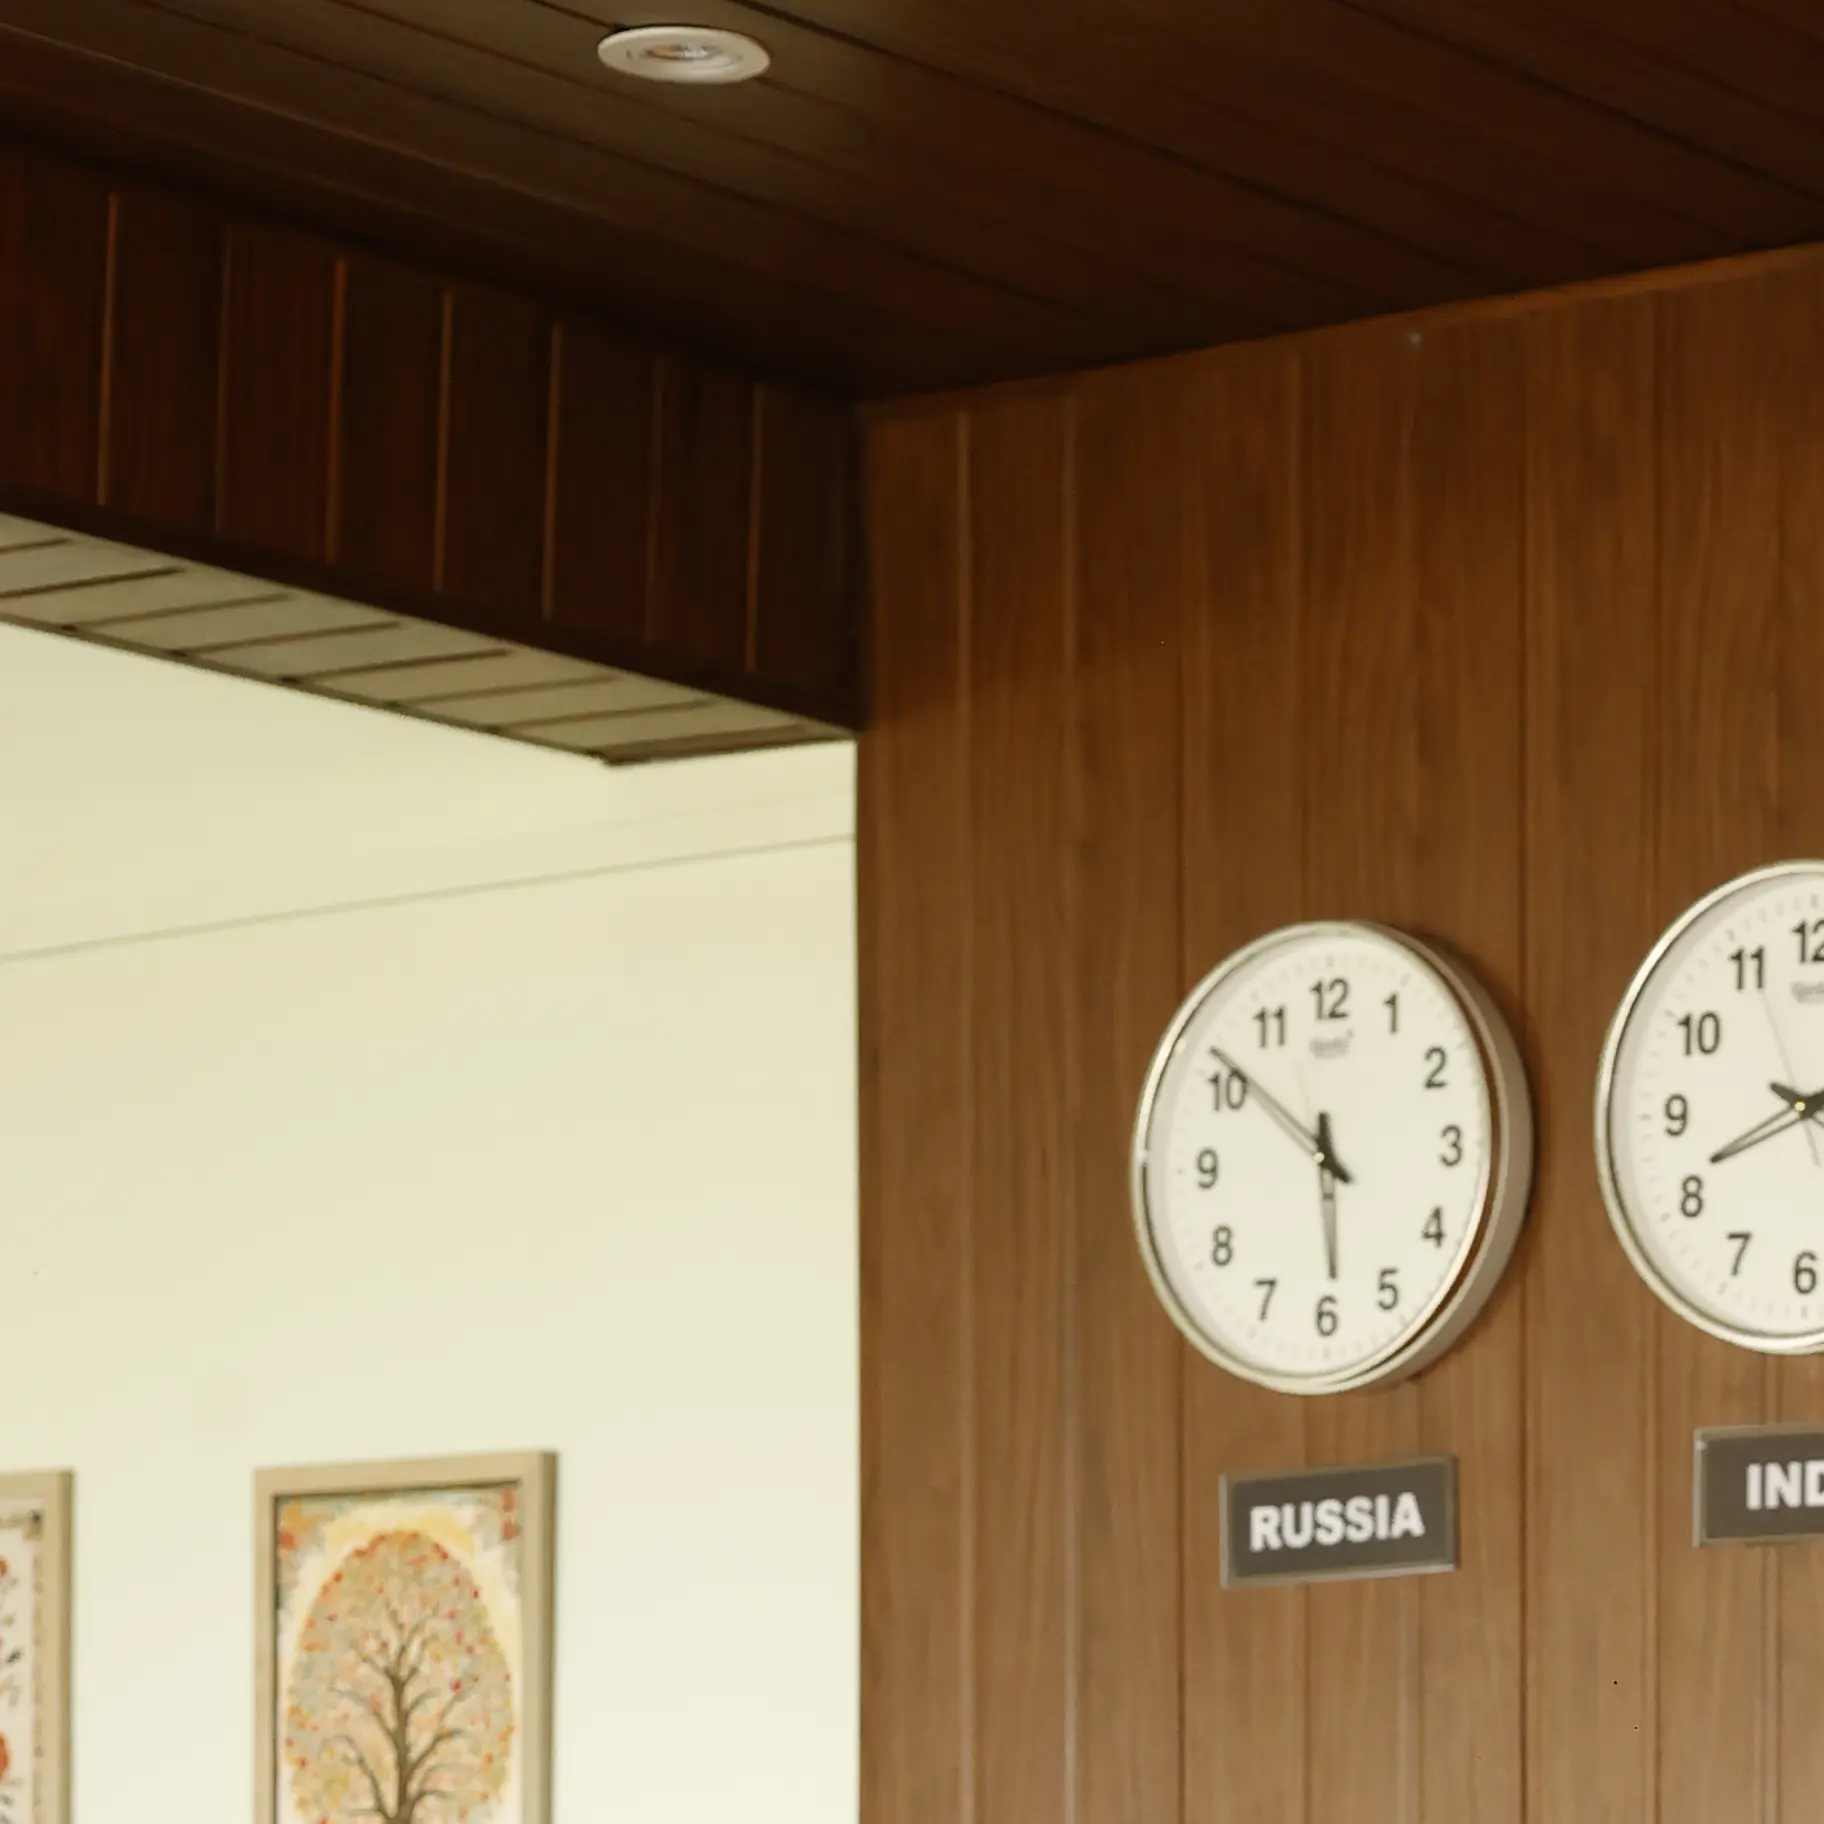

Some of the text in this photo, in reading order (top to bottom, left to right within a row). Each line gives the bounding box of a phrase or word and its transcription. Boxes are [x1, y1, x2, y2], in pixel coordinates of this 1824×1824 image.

[1728, 946, 1765, 991] 11
[1311, 978, 1349, 1020] 12
[1384, 993, 1398, 1033] 1
[1254, 1006, 1285, 1048] 11
[1677, 1011, 1721, 1056] 10
[1425, 1046, 1447, 1089] 2
[1209, 1068, 1248, 1112] 10
[1665, 1094, 1688, 1137] 9
[1441, 1125, 1463, 1167] 3
[1197, 1149, 1218, 1189] 9
[1680, 1175, 1704, 1218] 8
[1212, 1225, 1233, 1267] 8
[1422, 1207, 1445, 1248] 4
[1727, 1232, 1752, 1276] 7
[1793, 1251, 1817, 1295] 6
[1255, 1278, 1277, 1320] 7
[1378, 1268, 1399, 1311] 5
[1316, 1295, 1338, 1337] 6
[1250, 1491, 1426, 1553] RUSSIA
